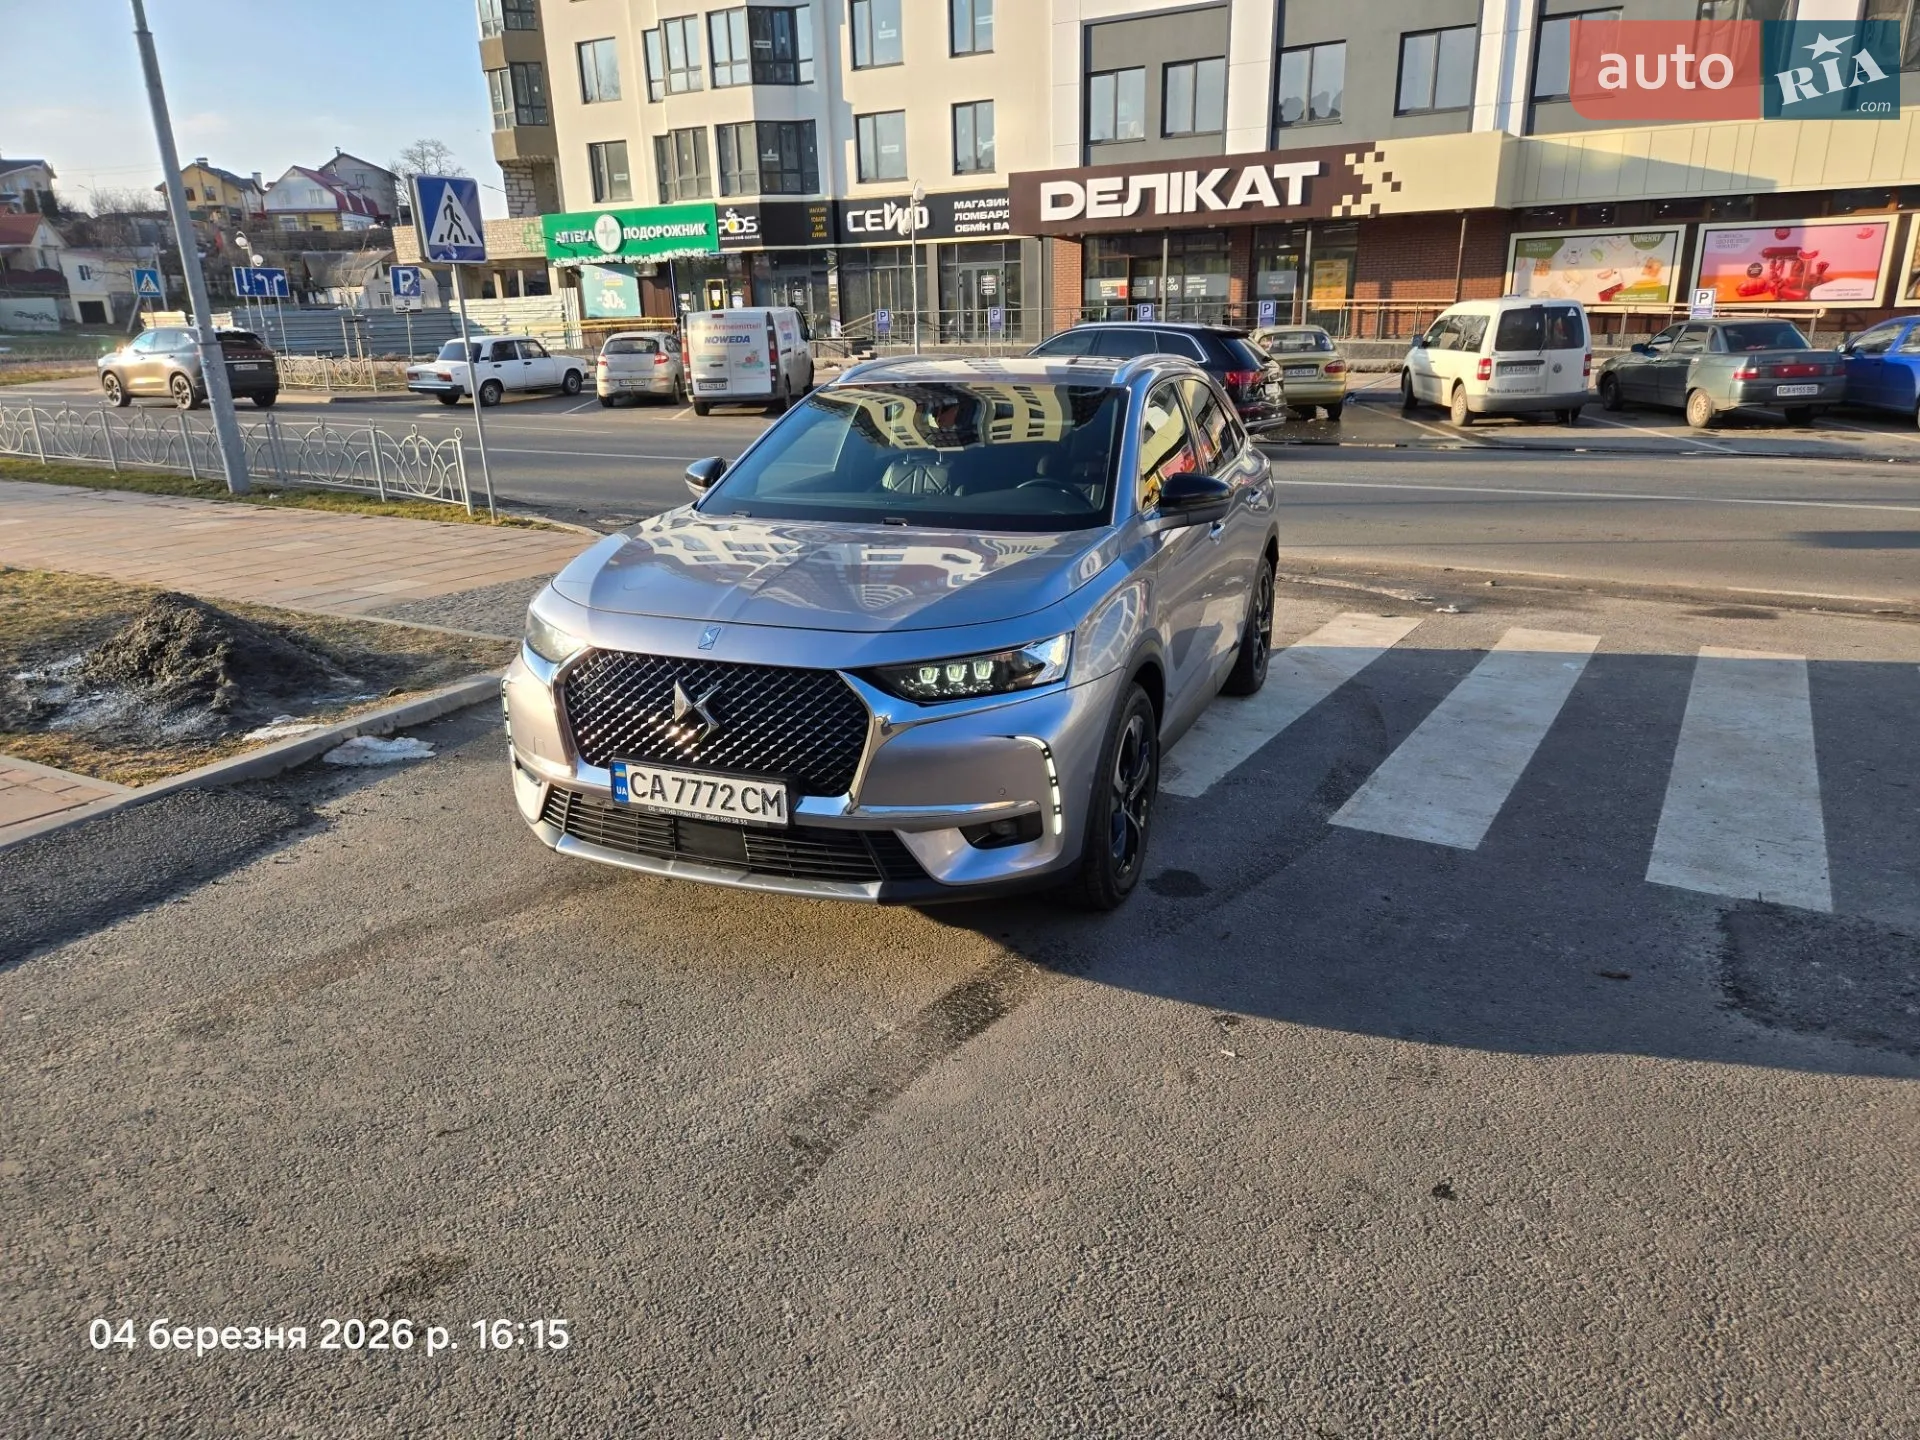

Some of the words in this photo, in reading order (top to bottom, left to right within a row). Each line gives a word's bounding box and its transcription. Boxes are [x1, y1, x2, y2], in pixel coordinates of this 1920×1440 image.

[954, 197, 1009, 210] МАГАЗИН
[955, 221, 991, 233] ОБМІН
[555, 229, 595, 244] АПТЕКА
[623, 223, 707, 240] ПОДОРОЖНИК
[704, 335, 751, 344] NOWEDA
[616, 785, 628, 796] UA
